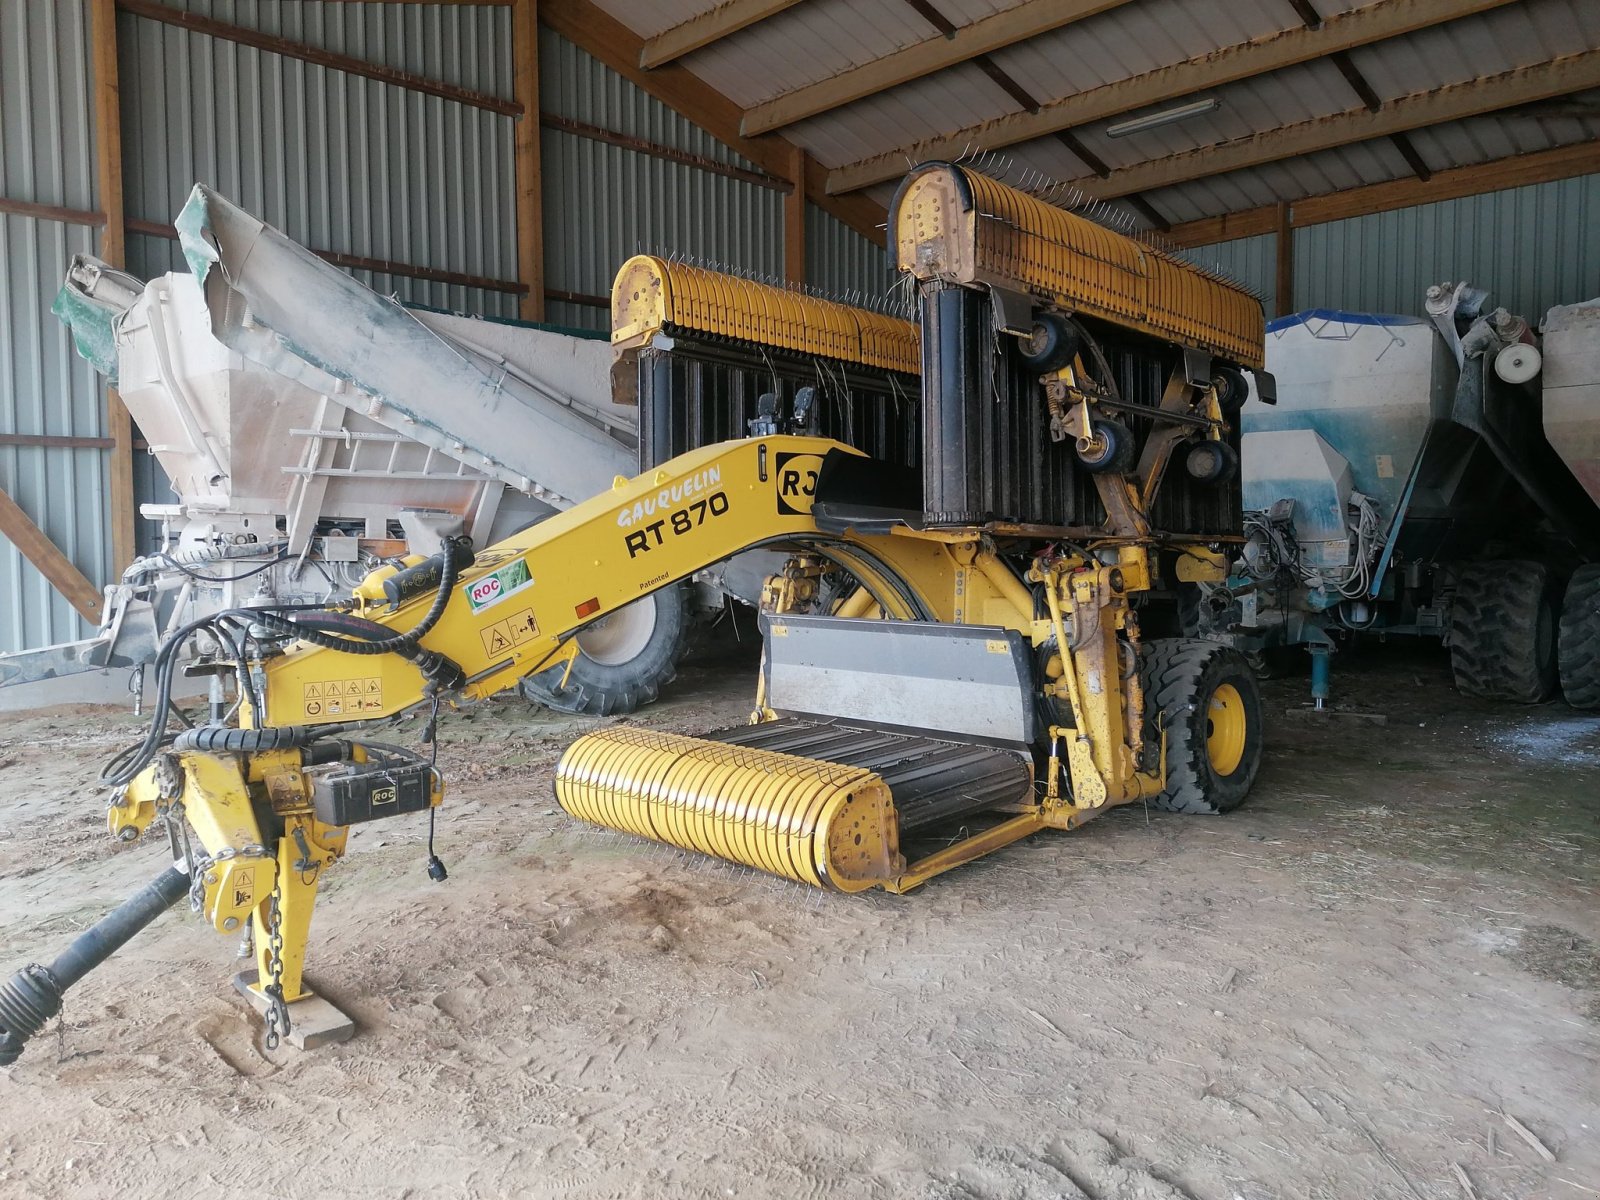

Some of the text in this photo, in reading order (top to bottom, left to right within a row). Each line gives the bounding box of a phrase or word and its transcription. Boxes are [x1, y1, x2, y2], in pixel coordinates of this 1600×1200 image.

[617, 464, 720, 527] GAUQUELIN
[625, 519, 665, 559] RT
[670, 491, 729, 536] 870
[473, 579, 499, 601] ROC
[639, 571, 670, 590] Patented
[374, 791, 395, 801] ROC
